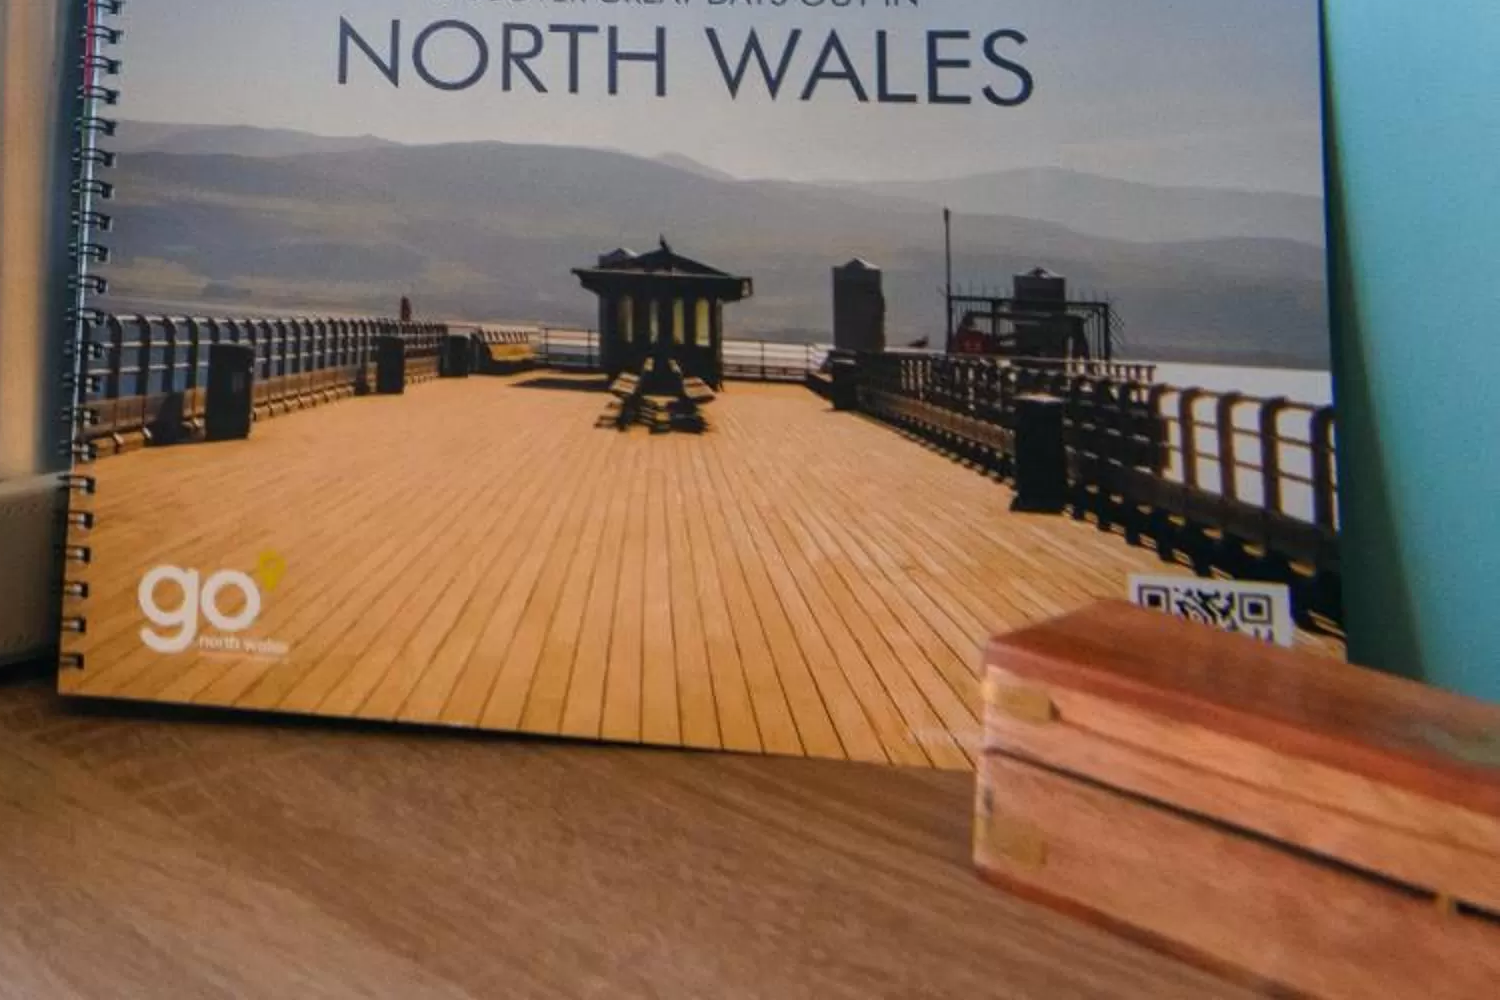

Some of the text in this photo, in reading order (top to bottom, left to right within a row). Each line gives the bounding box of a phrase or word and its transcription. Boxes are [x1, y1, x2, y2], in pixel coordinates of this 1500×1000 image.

[337, 15, 1034, 108] NORTH WALES
[137, 564, 262, 654] go
